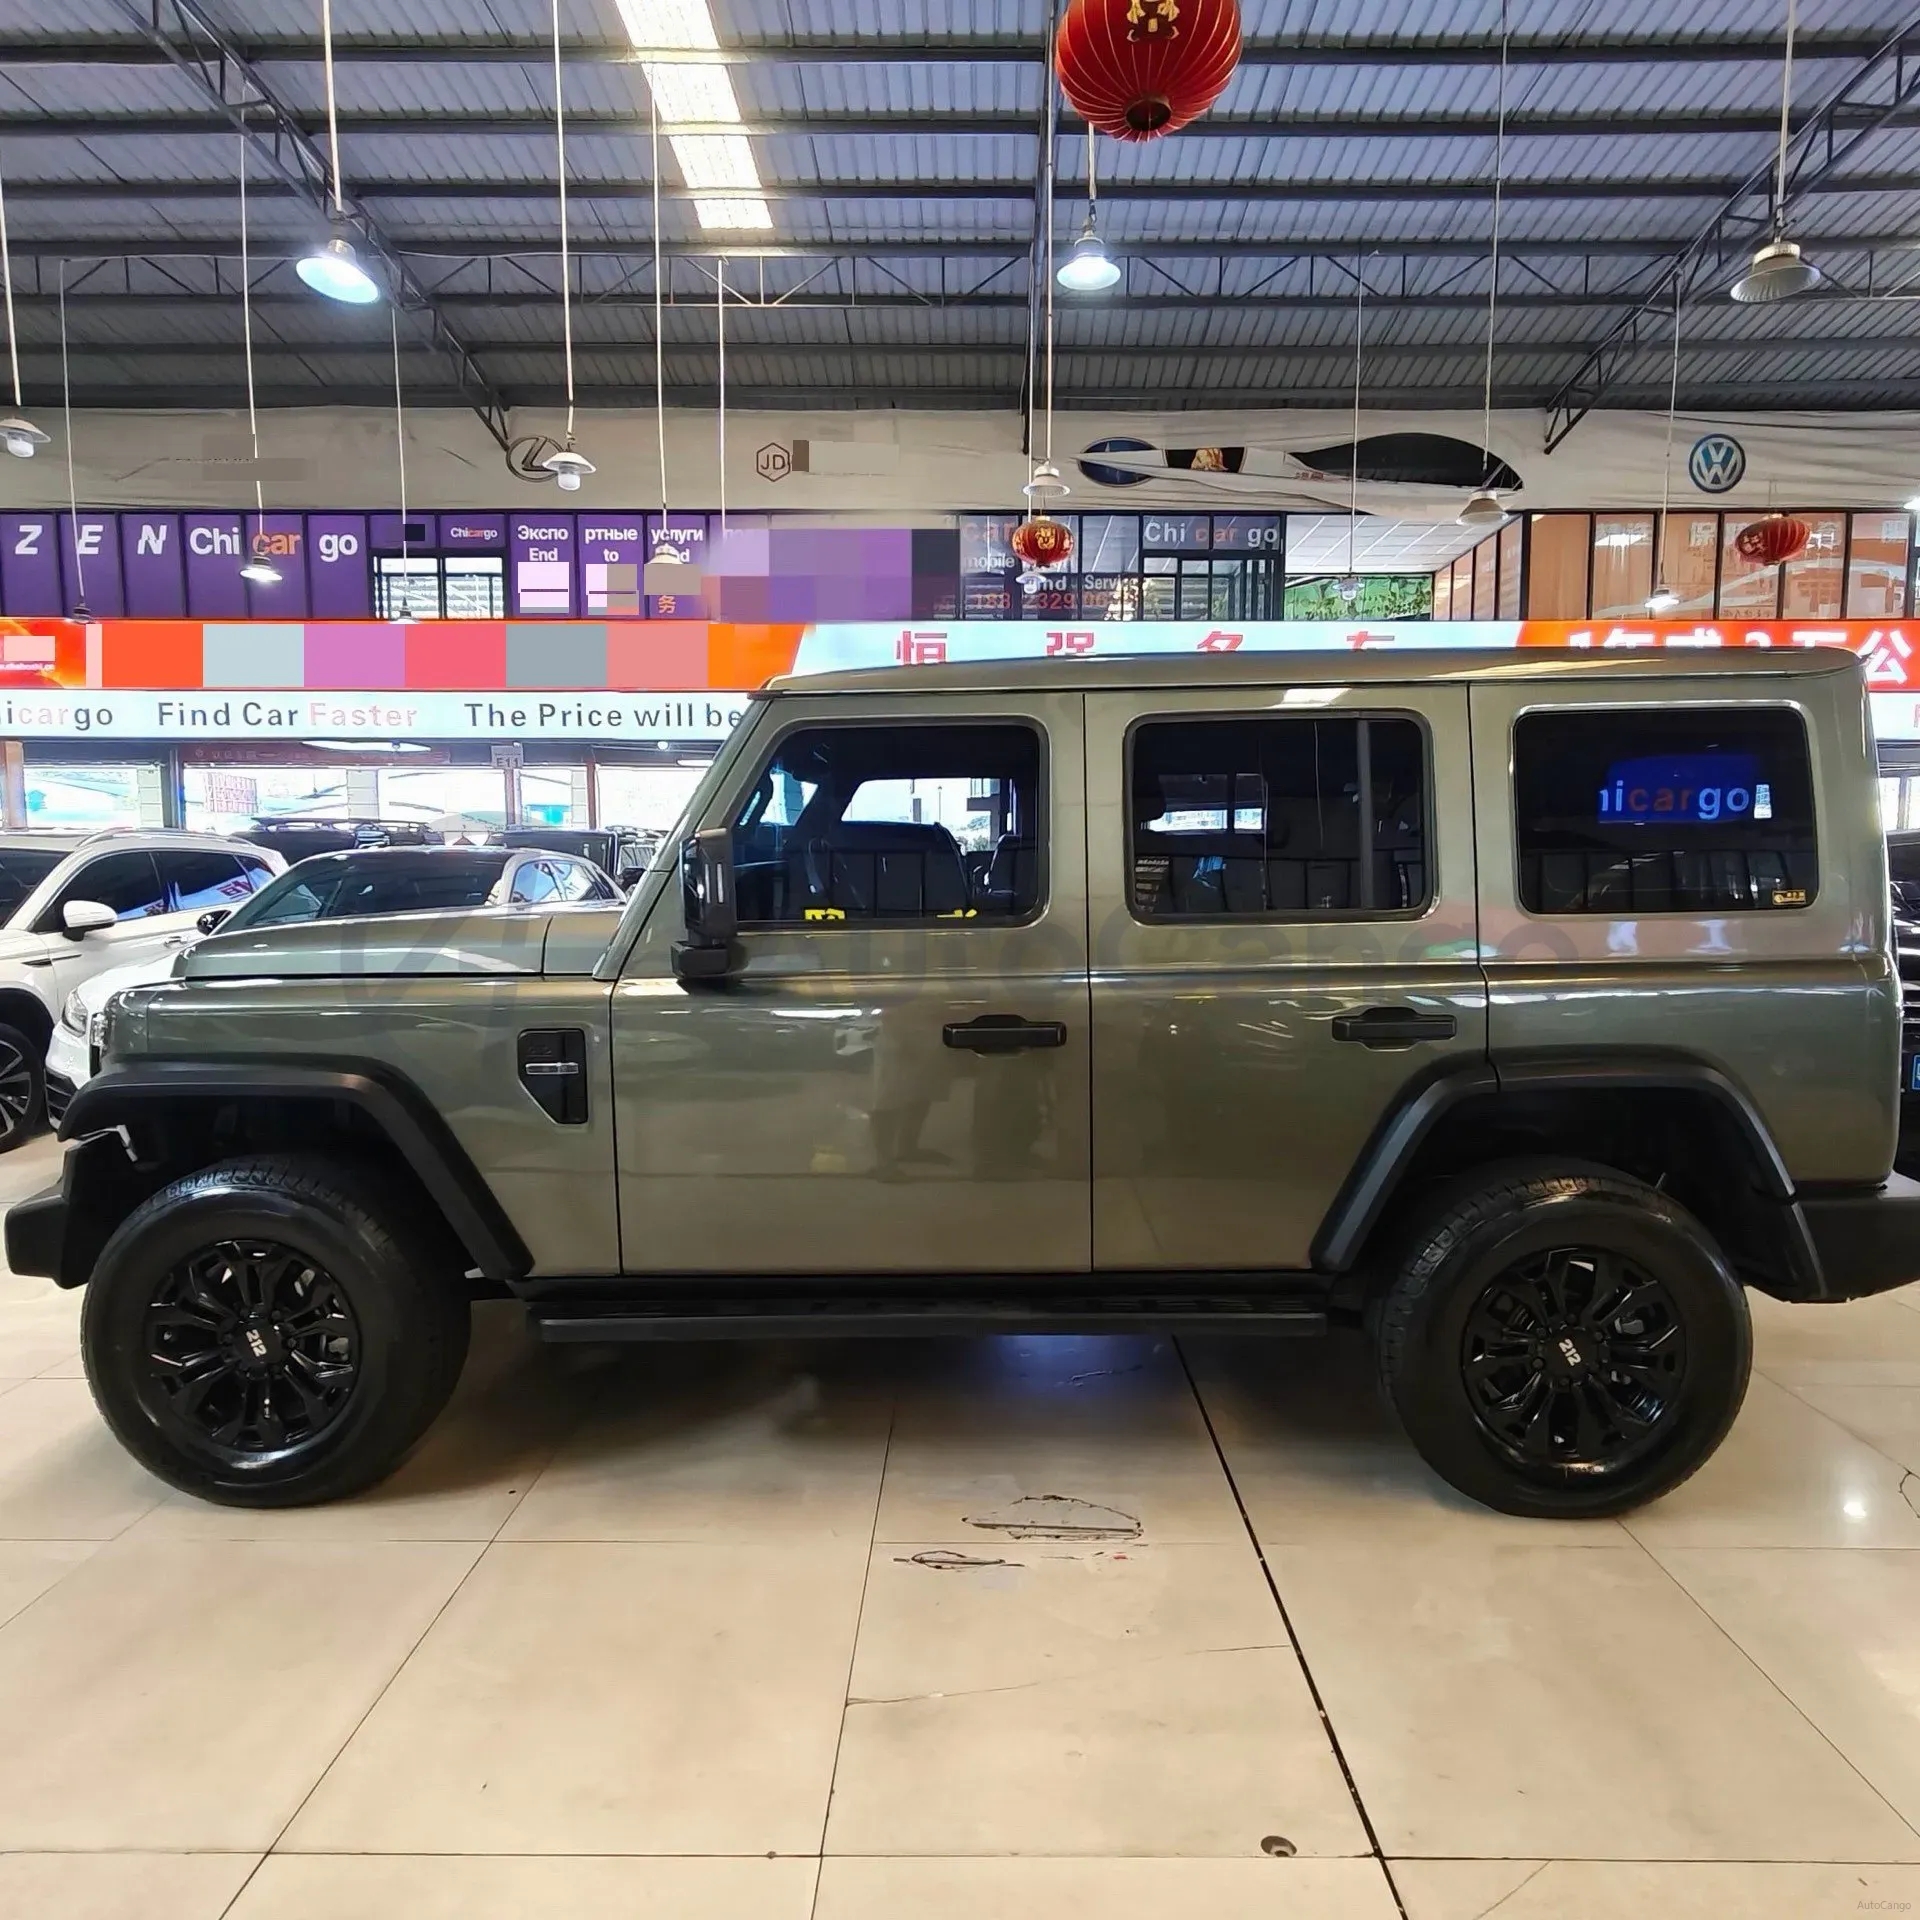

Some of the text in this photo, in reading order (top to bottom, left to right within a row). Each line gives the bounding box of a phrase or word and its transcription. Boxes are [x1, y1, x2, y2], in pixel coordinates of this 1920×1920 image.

[760, 454, 786, 470] JD
[528, 547, 619, 562] End to
[0, 700, 745, 731] icargo Find Car Faster The Price will be
[246, 1329, 267, 1357] 212
[1559, 1339, 1581, 1366] 212
